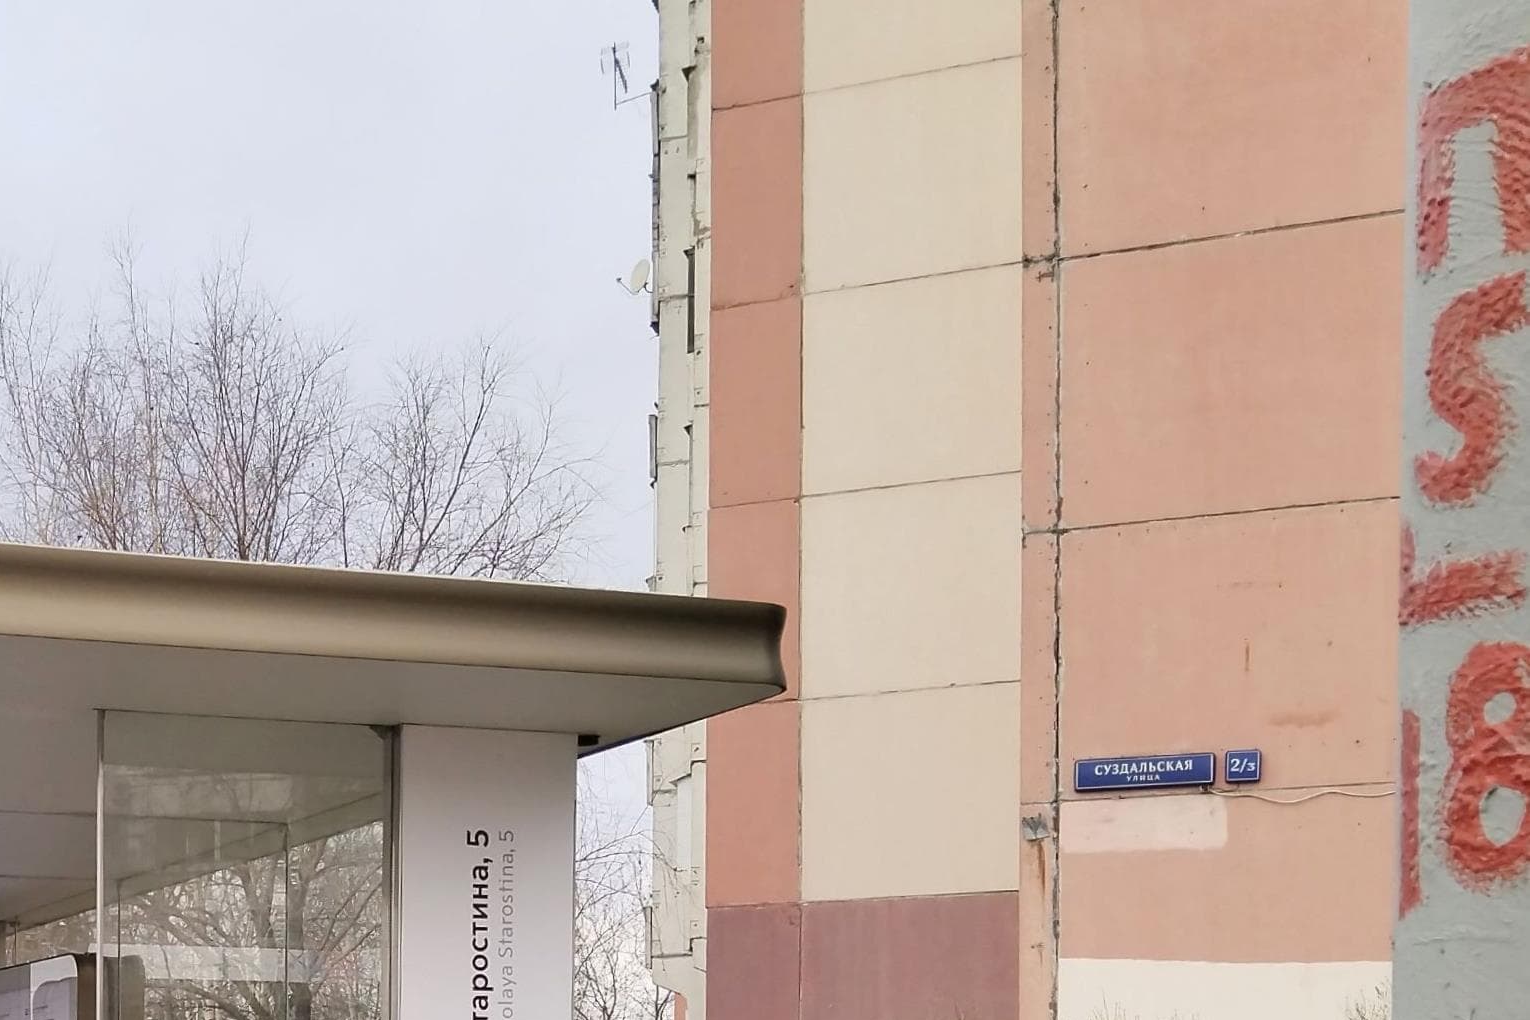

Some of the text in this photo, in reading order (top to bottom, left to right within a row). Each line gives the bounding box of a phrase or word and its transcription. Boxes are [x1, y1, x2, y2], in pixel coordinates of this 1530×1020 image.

[1094, 759, 1193, 776] СУЗДАЛЬСКАЯ
[1230, 758, 1256, 773] 2/3
[1126, 774, 1160, 782] УЛИЦА
[466, 829, 489, 847] 5
[499, 829, 515, 842] 5
[498, 848, 517, 959] Starostina,
